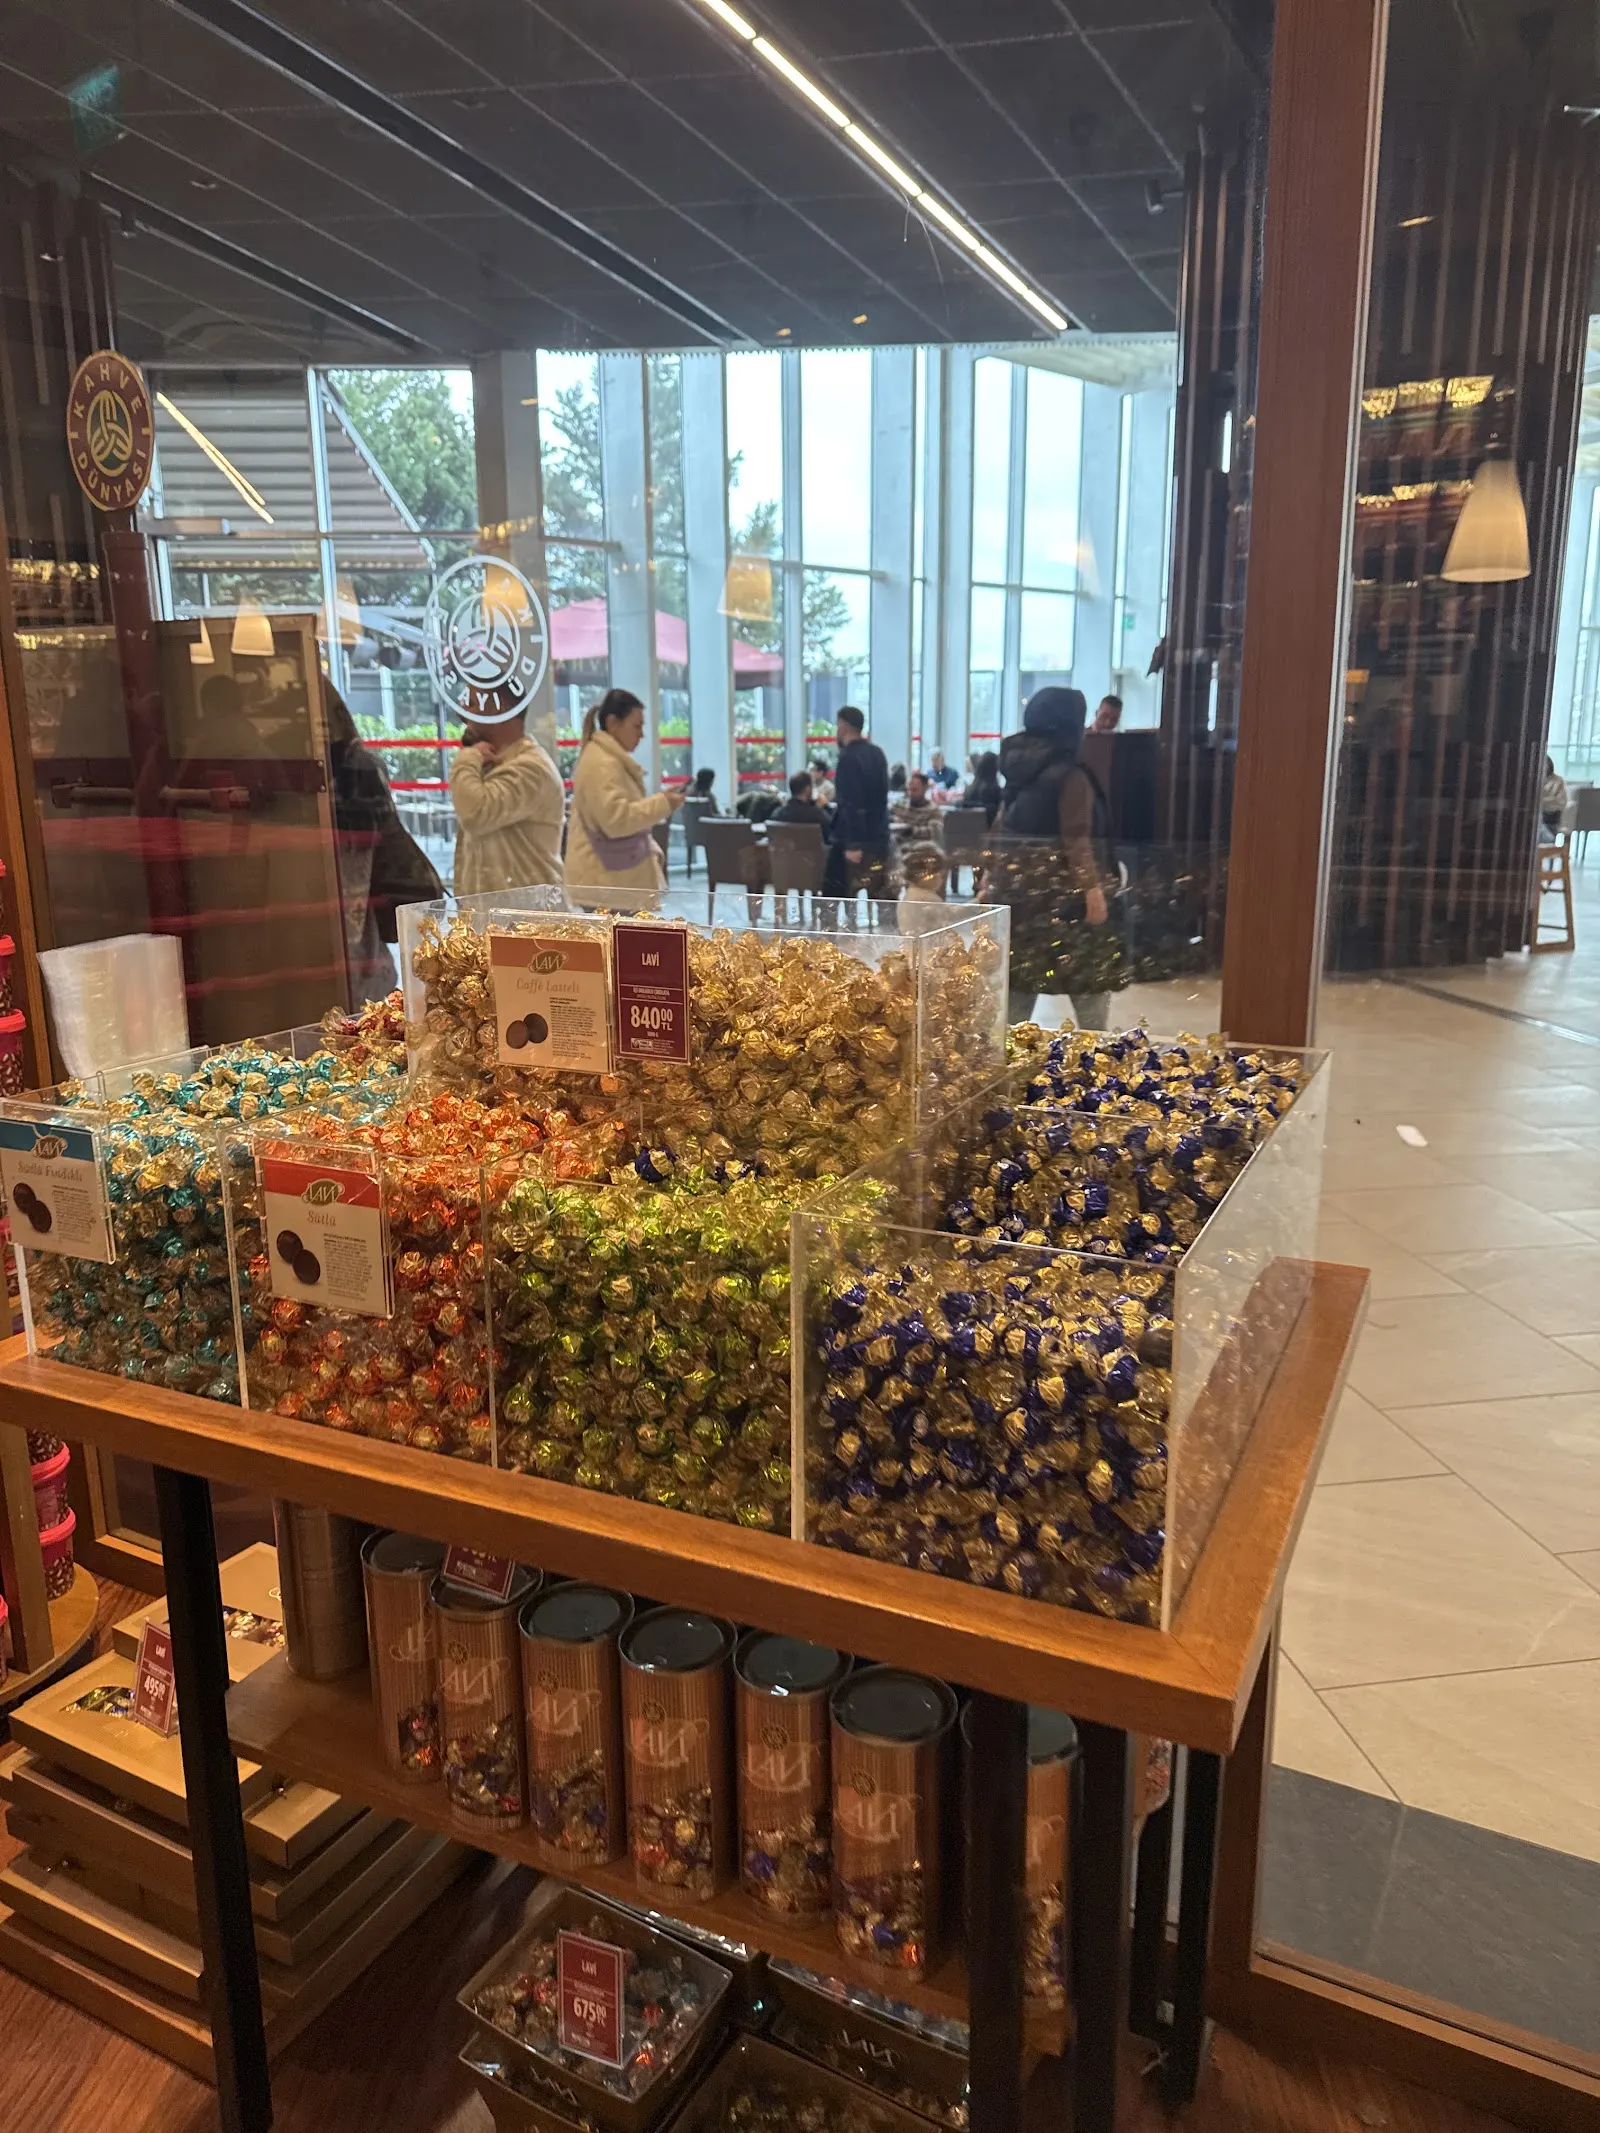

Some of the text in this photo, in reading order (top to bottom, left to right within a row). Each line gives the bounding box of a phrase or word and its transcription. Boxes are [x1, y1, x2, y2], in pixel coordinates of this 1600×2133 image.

[73, 362, 143, 419] KAHVE
[77, 448, 147, 503] DÜNYASI
[641, 951, 660, 967] LAVİ
[630, 1005, 673, 1030] 840 00
[661, 1022, 673, 1031] TL
[144, 1675, 160, 1698] 495
[573, 1996, 597, 2023] 675
